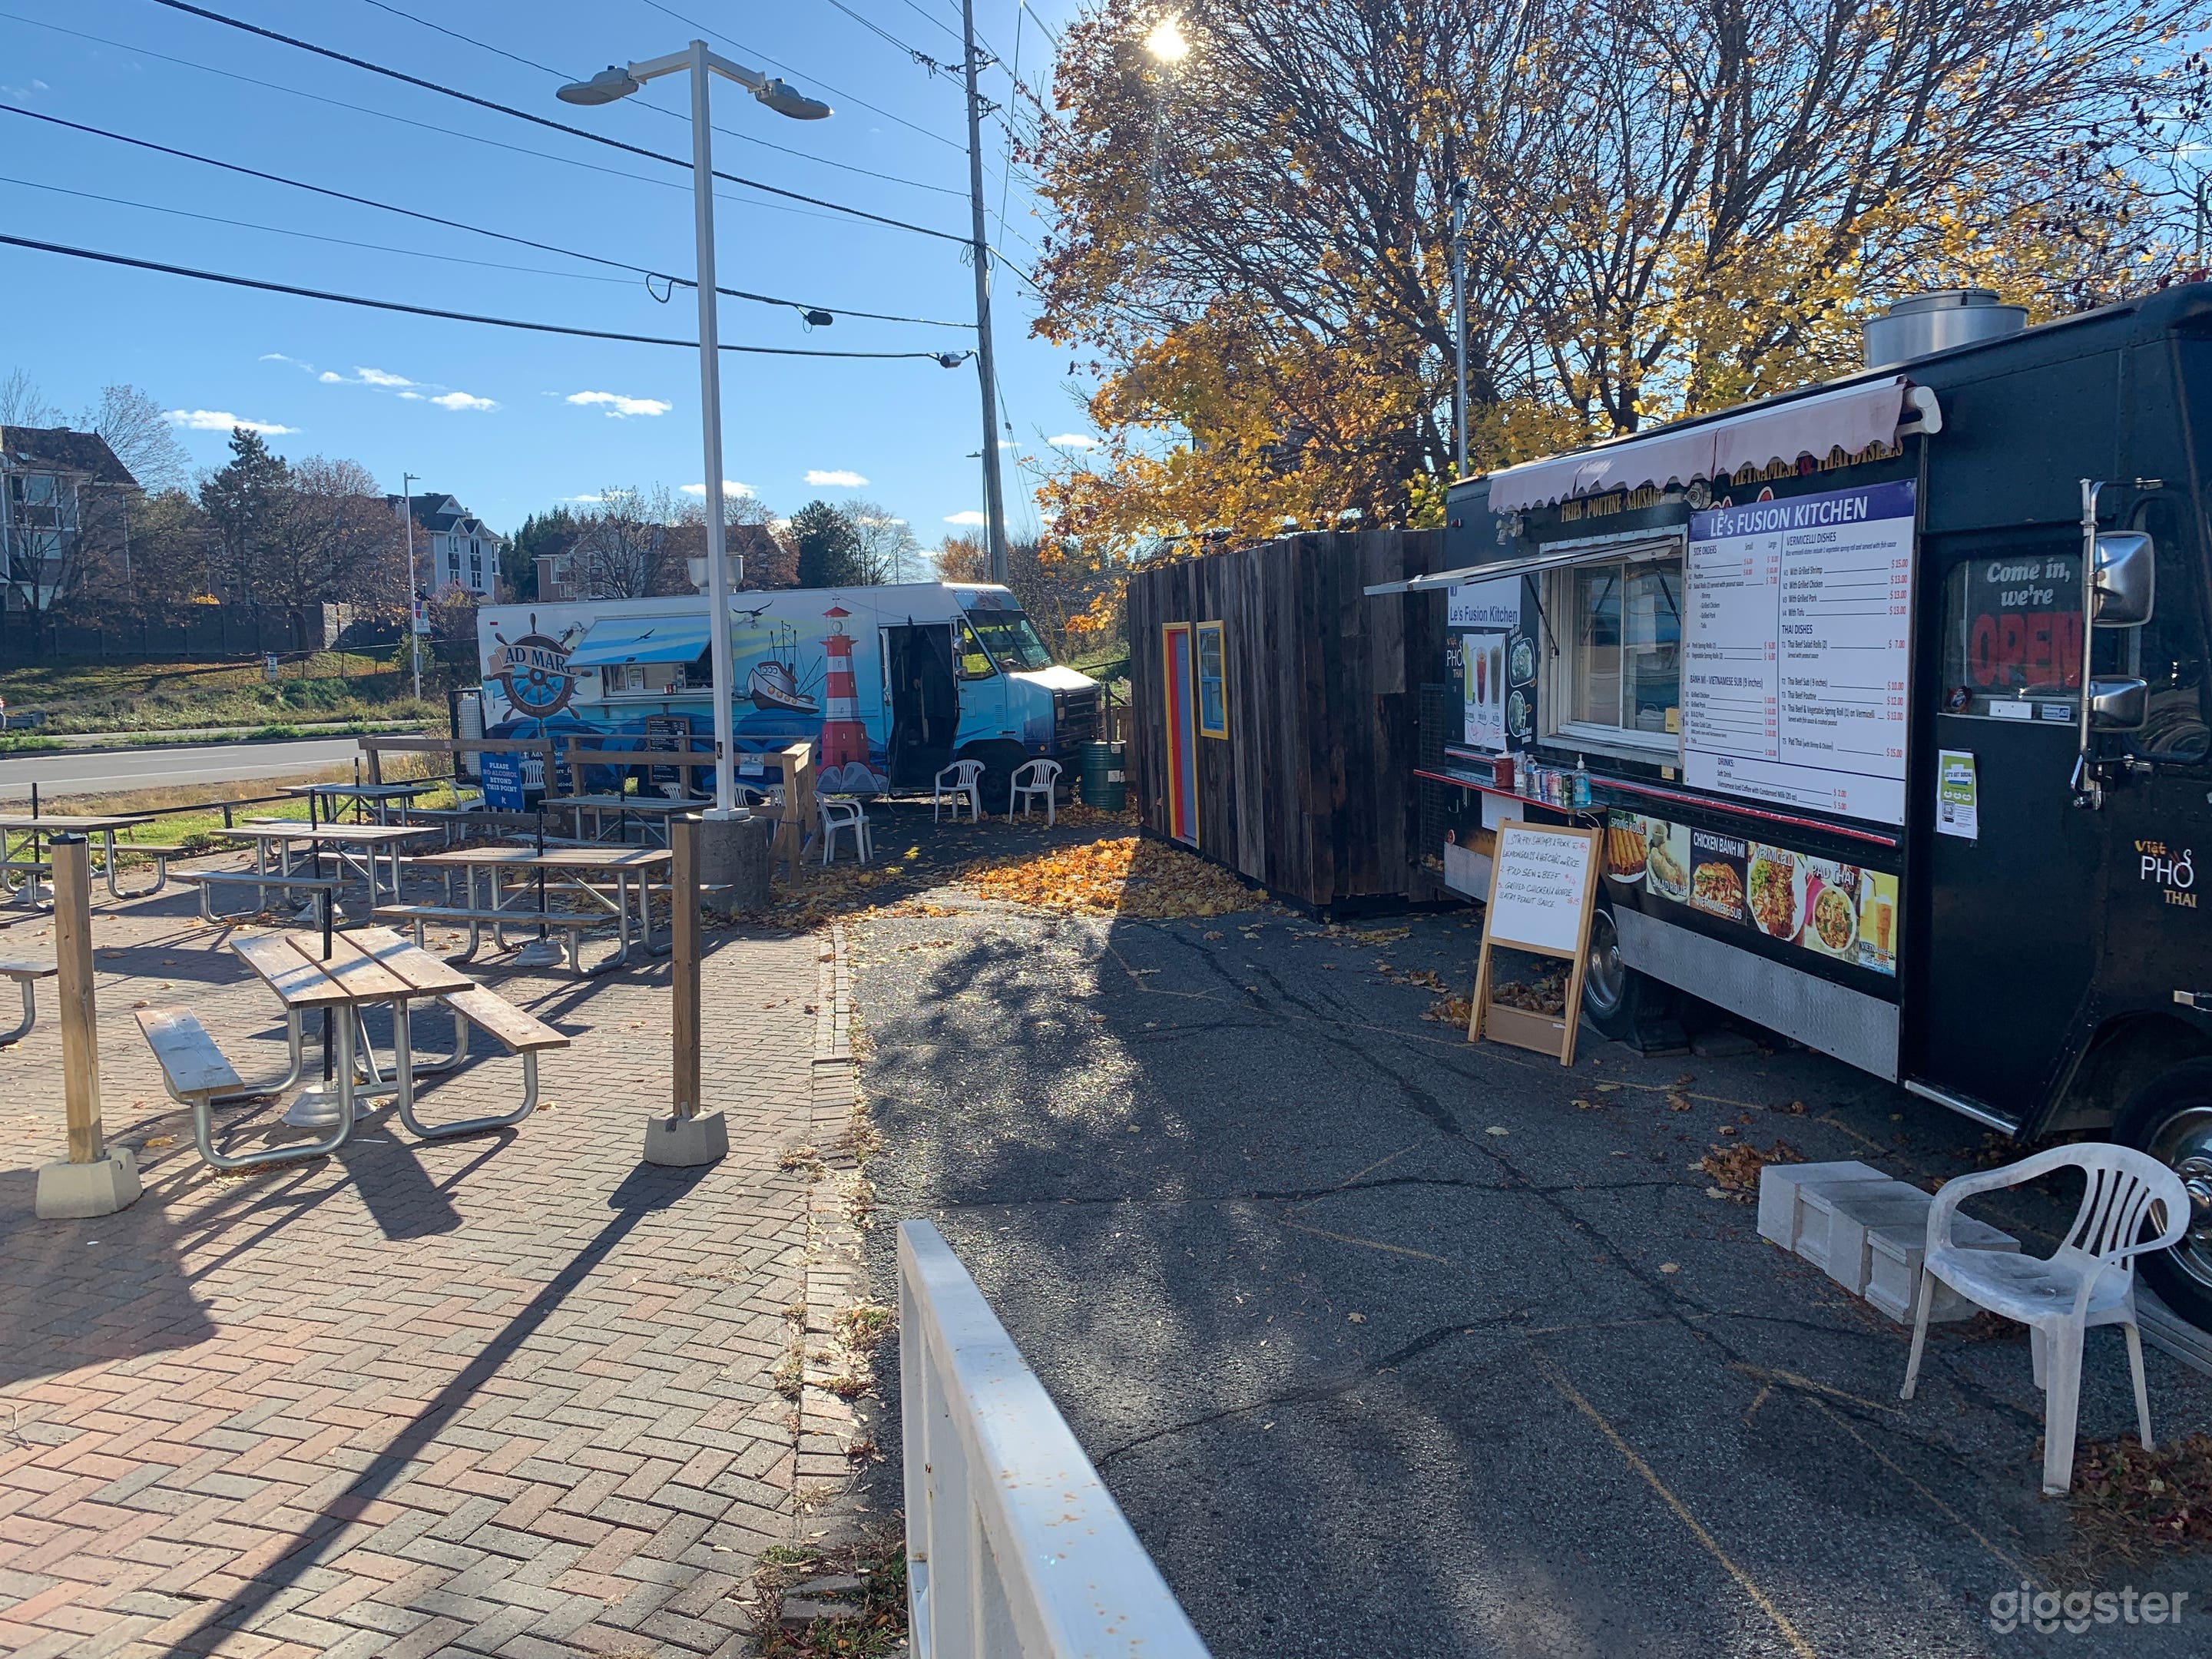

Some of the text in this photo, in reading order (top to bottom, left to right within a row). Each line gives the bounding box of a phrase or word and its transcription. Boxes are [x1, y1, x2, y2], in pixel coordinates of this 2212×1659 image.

[1851, 439, 1903, 465] DISS
[1561, 501, 1582, 523] FRIES
[1587, 493, 1621, 519] POUTINE
[1737, 507, 1790, 534] FUSION
[1794, 496, 1868, 527] KITCHEN
[1786, 531, 1836, 546] VERMICELLI DISHES
[1986, 557, 2071, 583] Come in,
[2001, 584, 2054, 607] we're
[1450, 605, 1518, 623] Le's Fusion Kitchen
[1782, 624, 1813, 634] THAI DISHES
[505, 647, 526, 664] AD
[1971, 611, 2083, 688] OPEN
[1709, 676, 1734, 687] VIETNAMESE
[1734, 677, 1742, 687] SUB
[1717, 757, 1735, 767] DRINKS:
[492, 770, 518, 778] ALCOHOL
[500, 784, 517, 793] POINT
[1611, 817, 1644, 836] SPRING ROLLS
[1693, 832, 1719, 852] CHICKEN
[1718, 835, 1737, 857] BÁNH
[1756, 847, 1795, 868] VERMICELLI
[1506, 866, 1522, 876] PAD
[1541, 870, 1561, 881] BEEF
[1813, 864, 1856, 886] PAD THAI
[1525, 884, 1550, 896] CHICKEN
[1652, 878, 1687, 898] SALAD ROLLS
[1517, 894, 1537, 905] PEANUT
[1696, 895, 1743, 920] VIETNAMESE SUB
[2163, 889, 2197, 909] THAI
